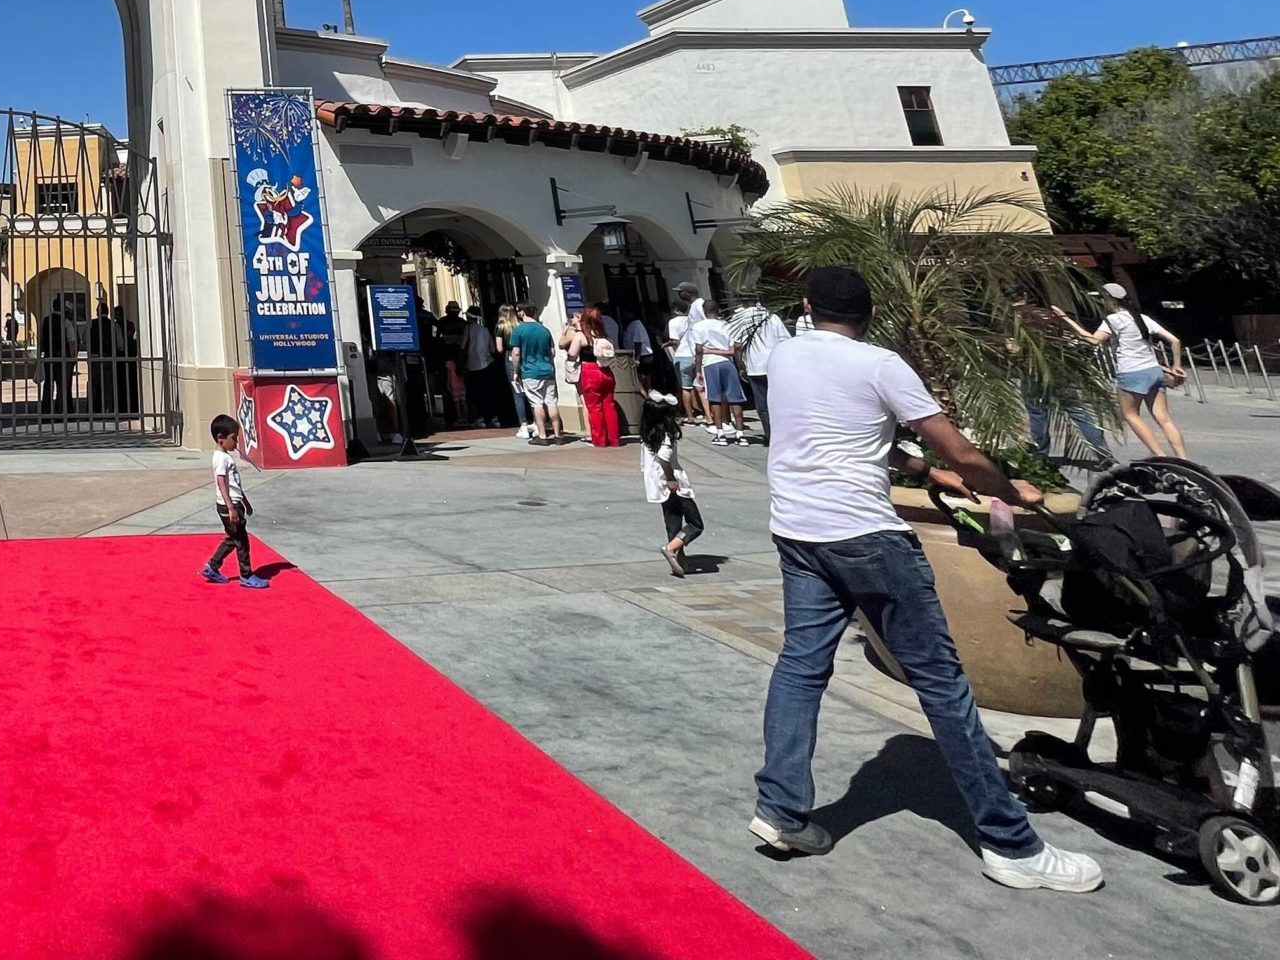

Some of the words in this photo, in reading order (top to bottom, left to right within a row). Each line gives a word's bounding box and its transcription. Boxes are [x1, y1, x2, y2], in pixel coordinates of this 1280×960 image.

[252, 244, 284, 275] 4TH
[287, 252, 310, 275] OF
[255, 275, 307, 302] JULY
[257, 302, 326, 316] CELEBRATION
